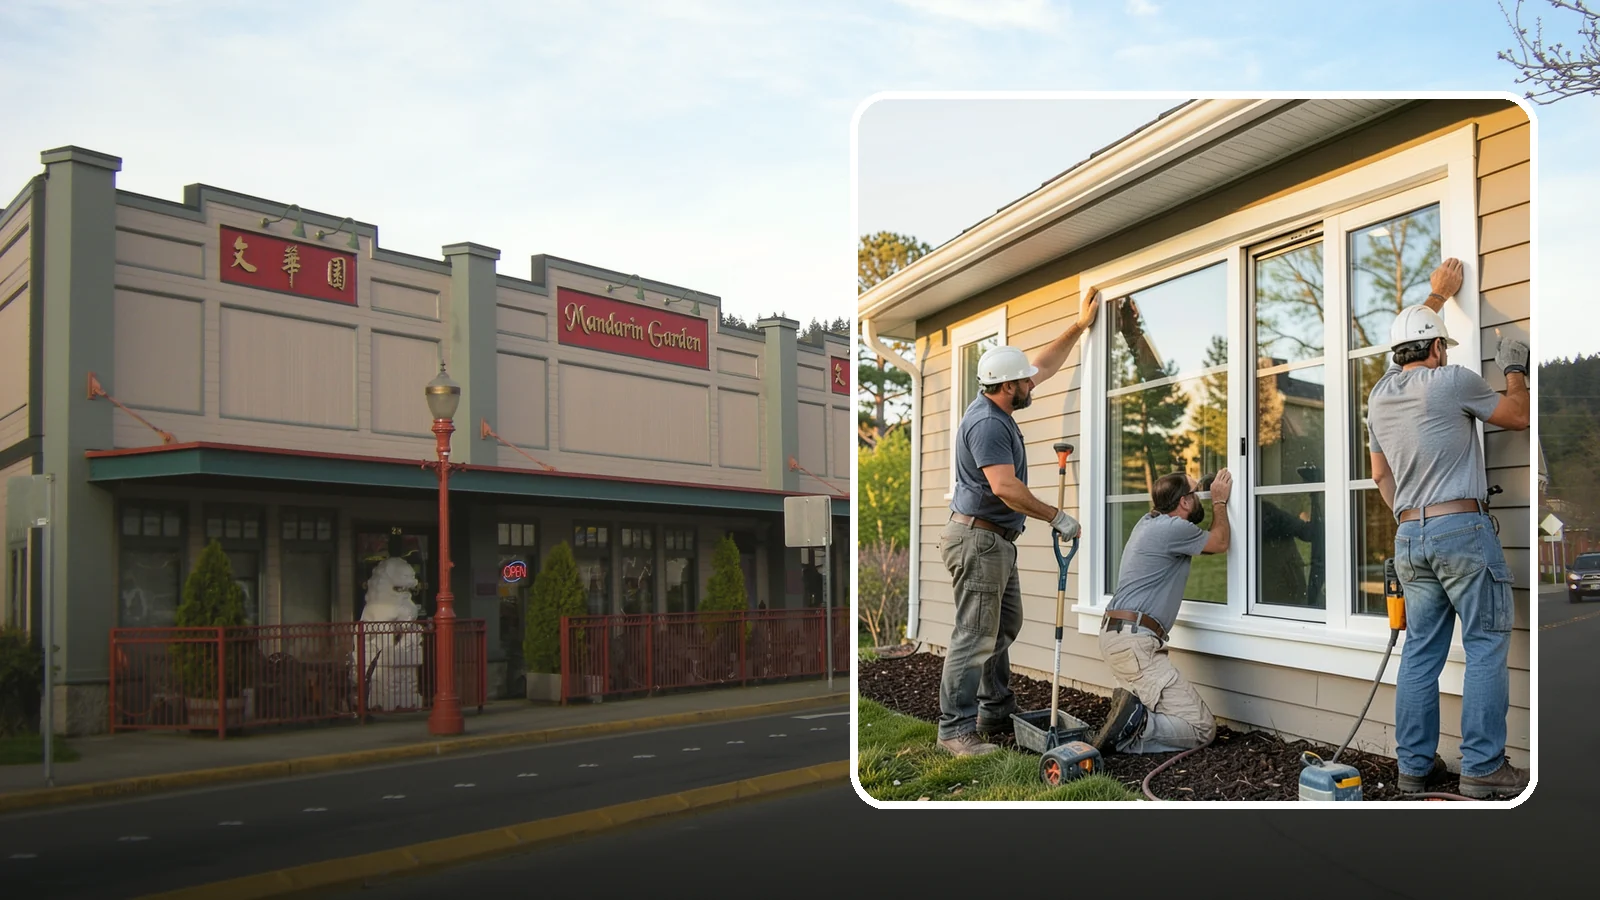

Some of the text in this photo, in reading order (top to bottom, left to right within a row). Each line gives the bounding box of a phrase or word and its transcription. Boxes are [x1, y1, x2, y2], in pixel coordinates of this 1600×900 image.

[231, 235, 347, 291] 文華園
[564, 302, 701, 352] Mandarin Garden
[503, 565, 527, 578] OPEN
